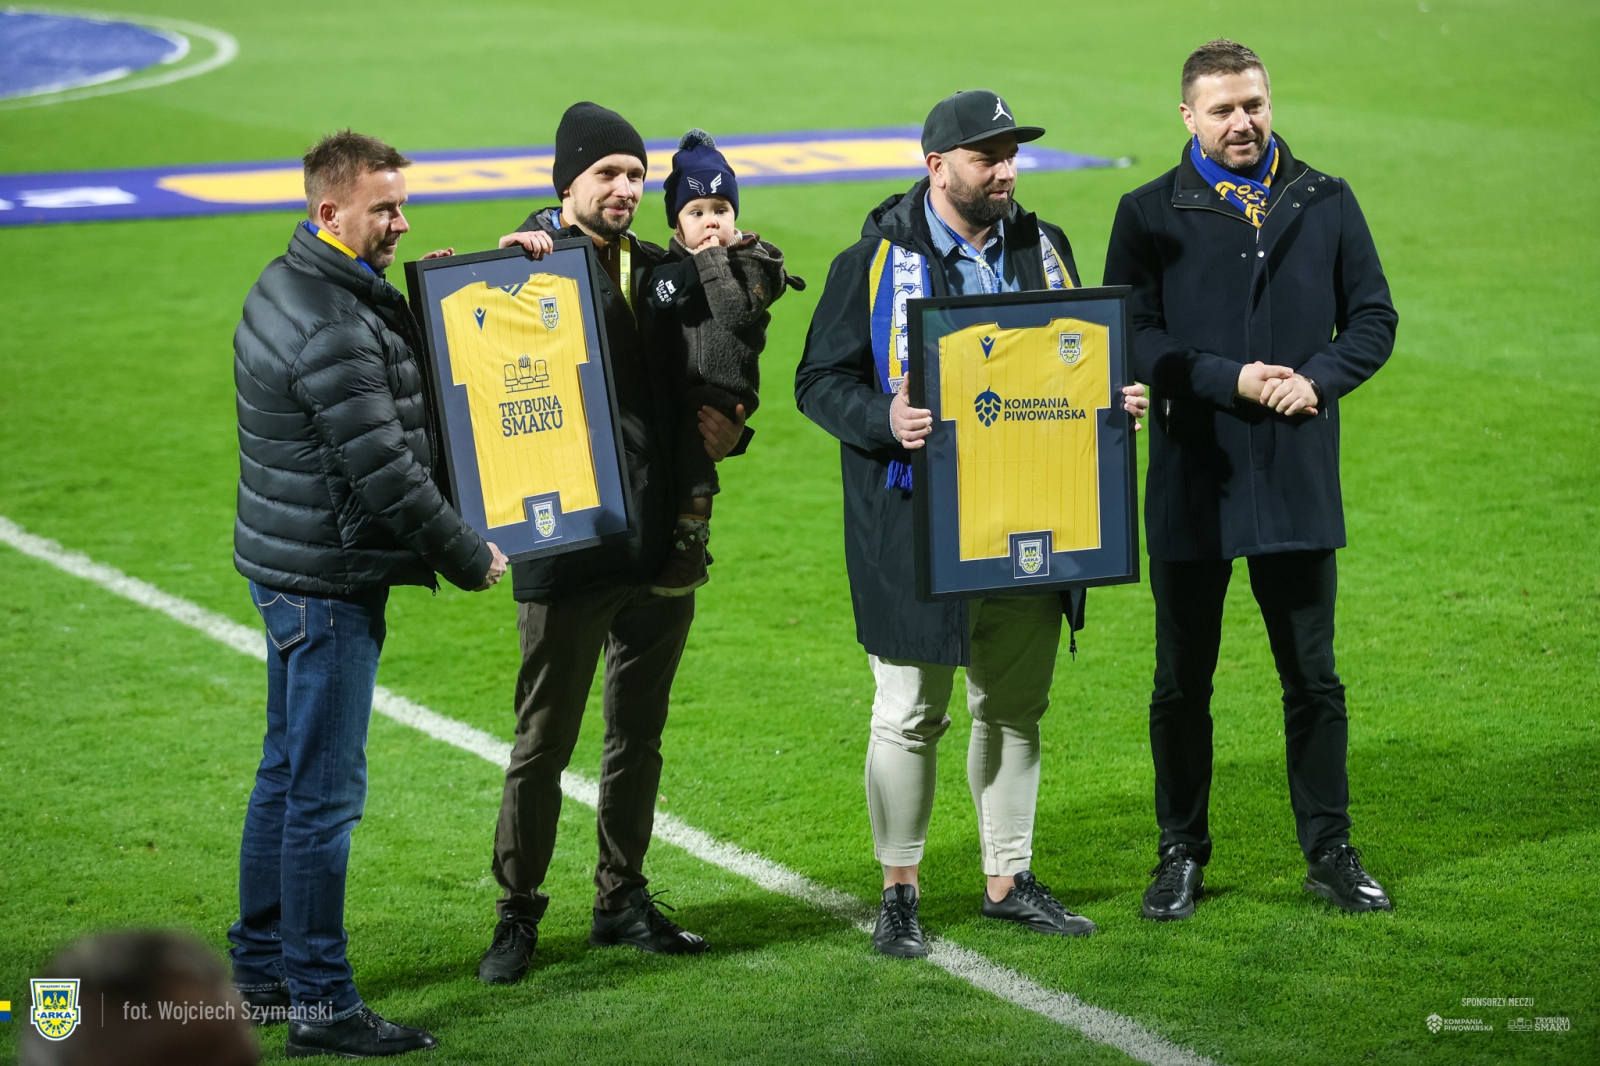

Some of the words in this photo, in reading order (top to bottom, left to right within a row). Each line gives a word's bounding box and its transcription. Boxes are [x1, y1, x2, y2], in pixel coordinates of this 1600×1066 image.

[499, 395, 561, 418] TRYBUNA
[1004, 397, 1070, 410] KOMPANIA
[502, 410, 563, 437] SMAKU
[1004, 408, 1086, 421] PIWOWARSKA
